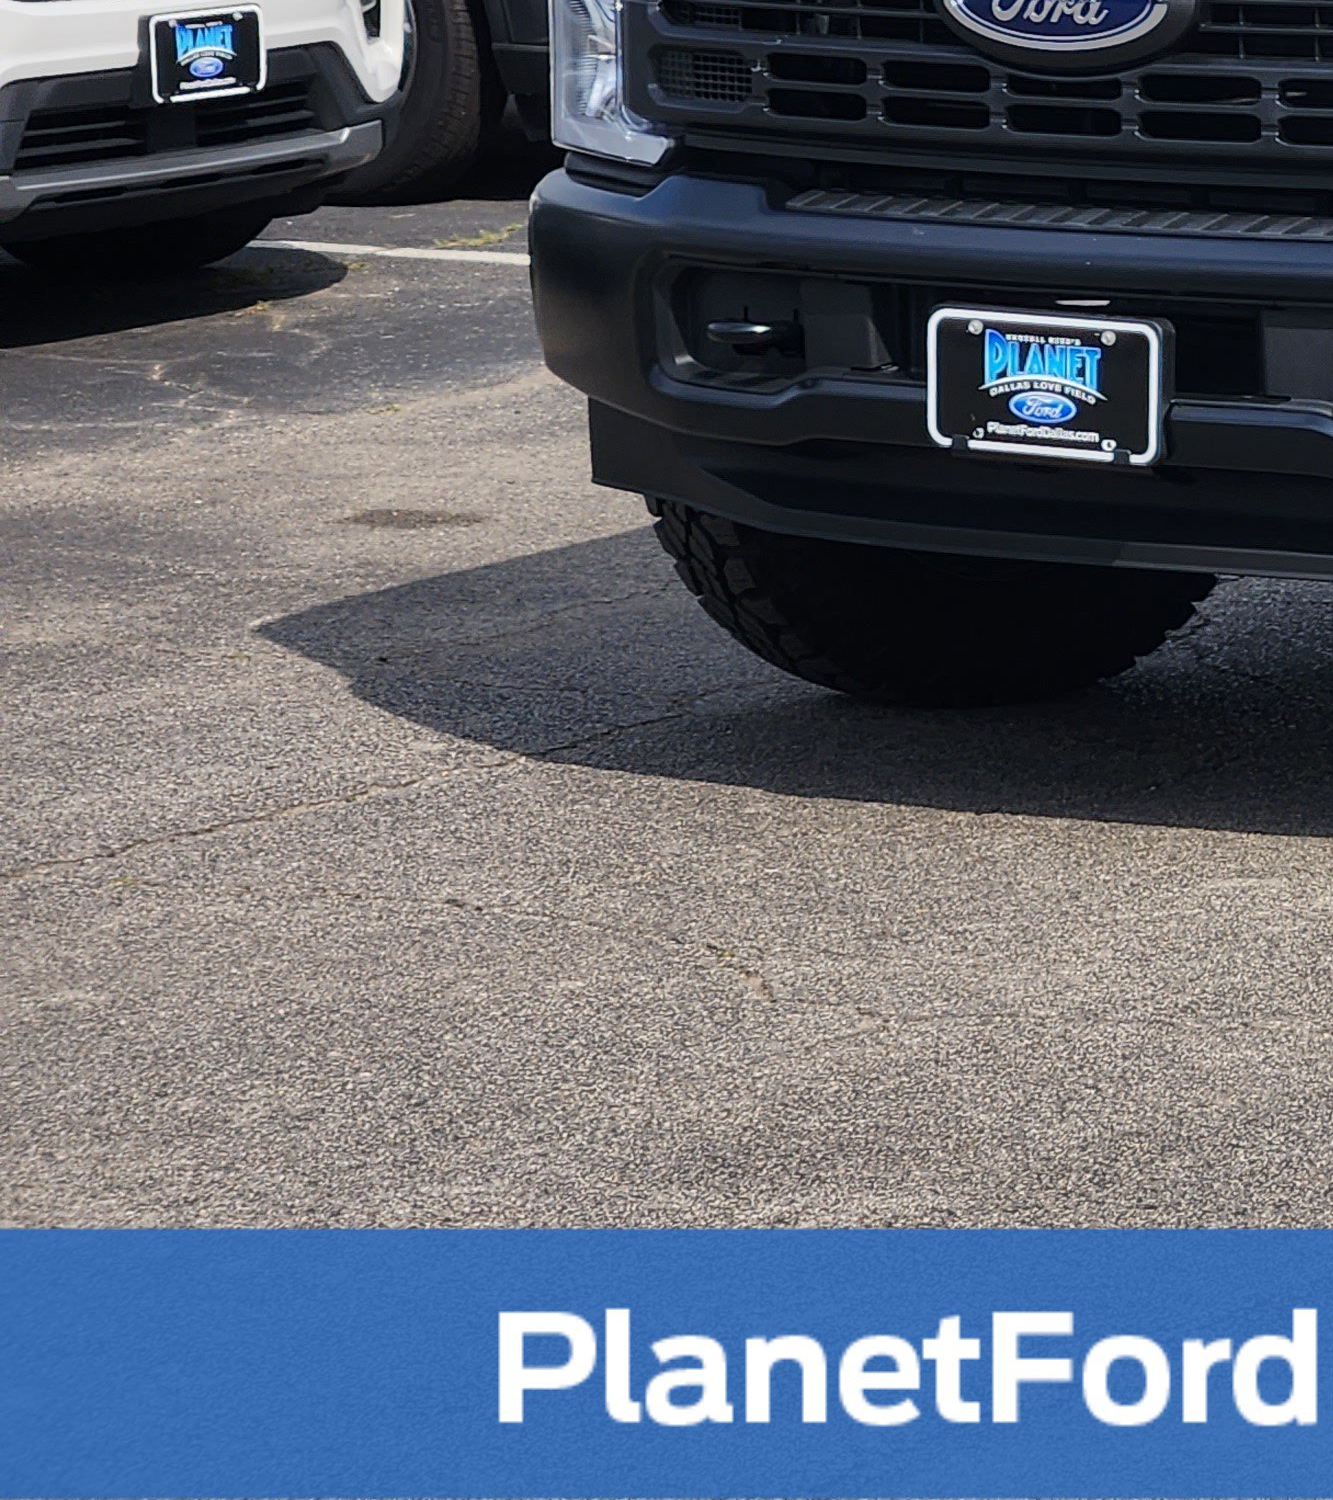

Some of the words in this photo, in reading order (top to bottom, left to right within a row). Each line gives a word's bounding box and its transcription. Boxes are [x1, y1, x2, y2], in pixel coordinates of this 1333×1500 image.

[175, 23, 233, 62] PLANET
[984, 328, 1102, 391] PLANET
[989, 381, 1031, 398] DALLAS
[1033, 381, 1062, 393] LOVE
[1064, 386, 1096, 406] FIELD
[1022, 395, 1063, 419] Ford
[986, 421, 1100, 443] PlanetFordDallas.com
